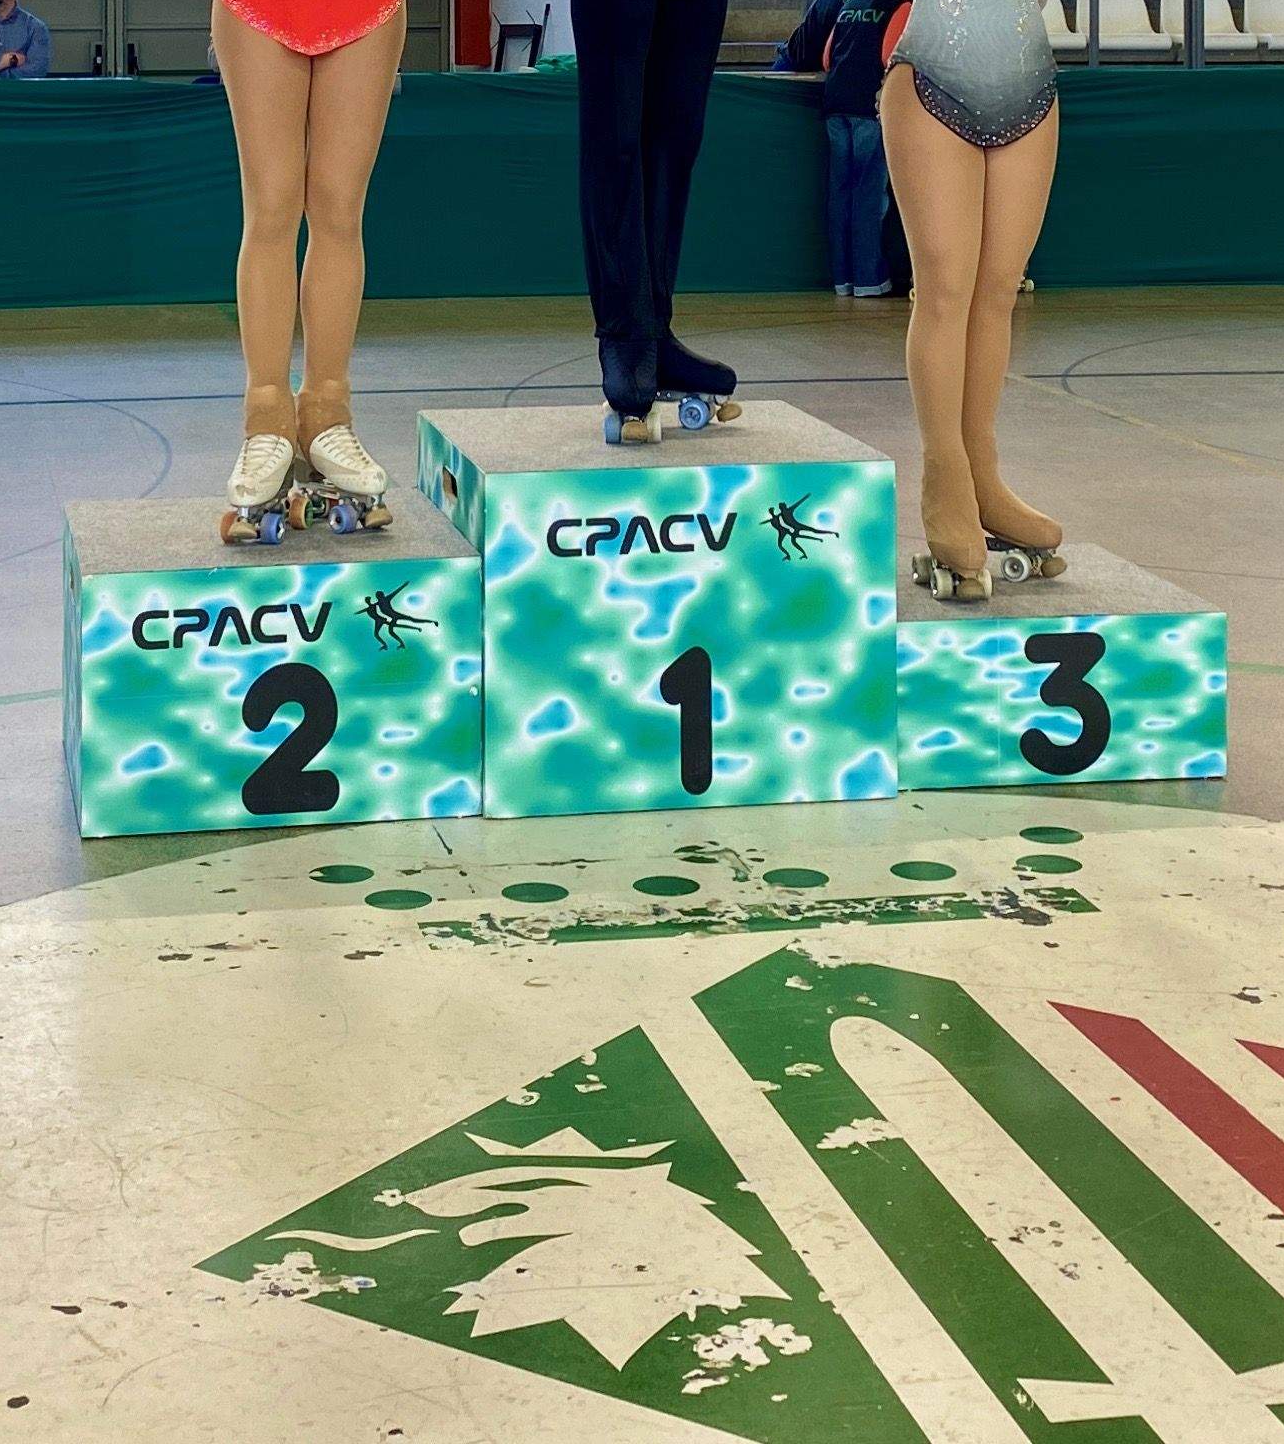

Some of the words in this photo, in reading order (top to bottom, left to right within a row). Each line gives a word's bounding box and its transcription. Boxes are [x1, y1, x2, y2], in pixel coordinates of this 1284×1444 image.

[837, 8, 885, 24] CPACV
[546, 512, 738, 558] CPACV
[131, 602, 333, 650] CPACV
[241, 662, 340, 816] 2
[659, 646, 713, 796] 1
[1019, 632, 1112, 776] 3
